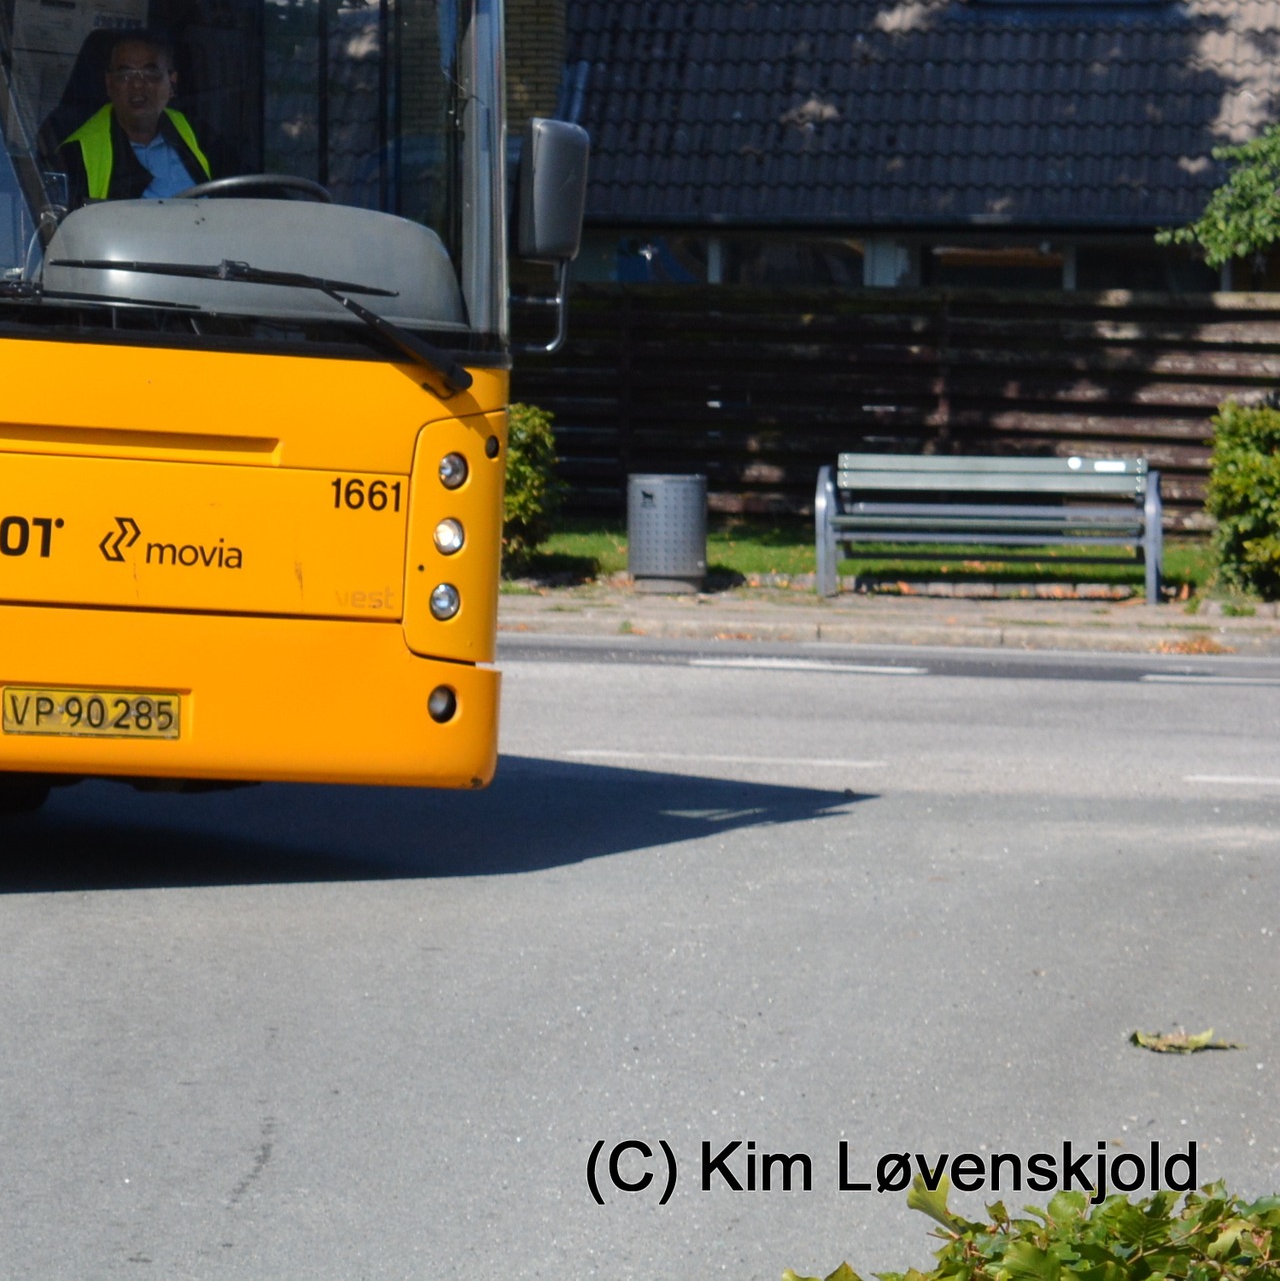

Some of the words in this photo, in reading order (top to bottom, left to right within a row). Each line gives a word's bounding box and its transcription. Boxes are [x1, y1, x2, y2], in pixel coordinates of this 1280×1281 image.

[331, 477, 402, 513] 1661
[146, 537, 244, 569] movia
[10, 694, 54, 722] VP
[65, 698, 106, 727] 90
[114, 700, 175, 731] 285
